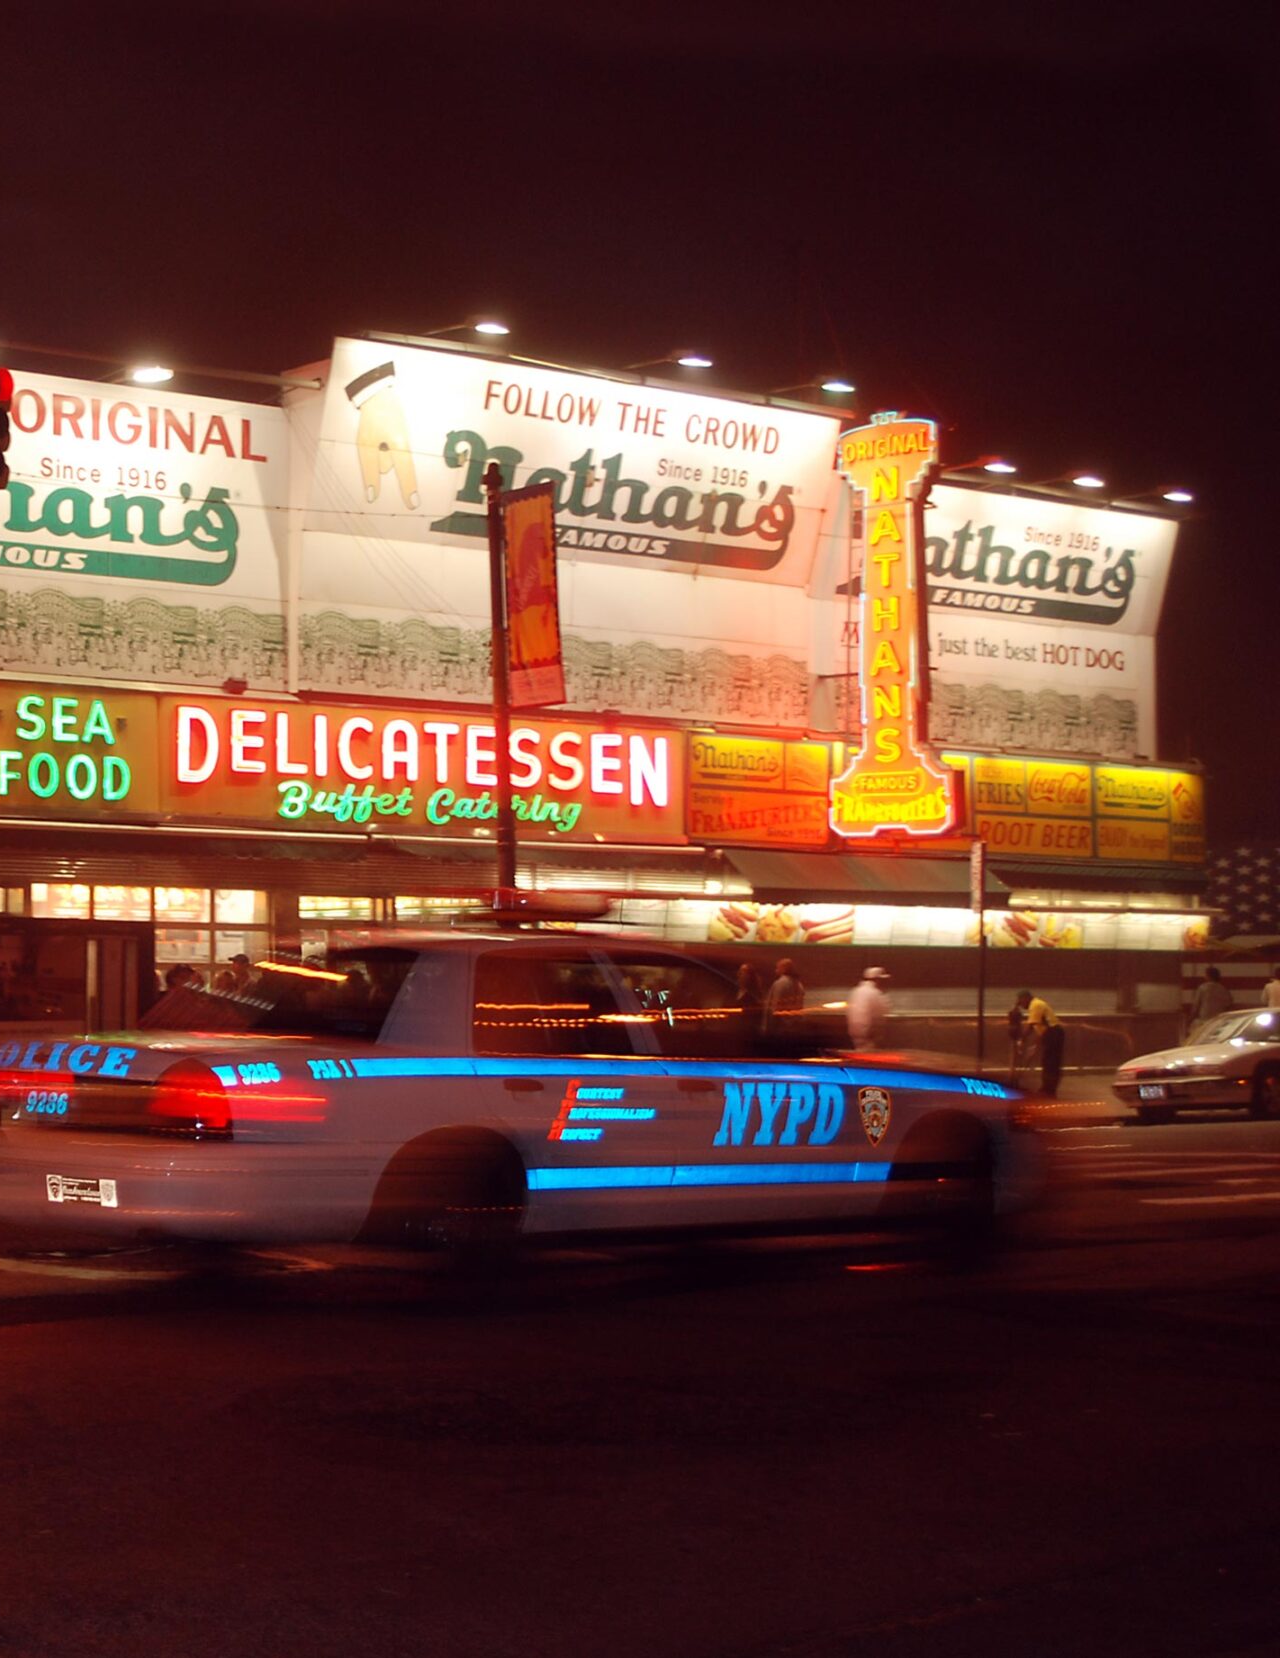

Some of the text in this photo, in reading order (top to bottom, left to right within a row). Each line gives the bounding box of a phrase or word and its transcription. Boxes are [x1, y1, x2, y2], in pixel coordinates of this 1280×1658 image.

[11, 388, 269, 464] ORIGINAL
[484, 379, 781, 456] FOLLOW THE CROWD
[842, 429, 930, 463] ORIGINAL
[40, 456, 168, 492] Since 1916
[657, 457, 749, 488] Since 1916
[1023, 525, 1100, 552] Since 1916
[924, 519, 1137, 600] athan's
[869, 465, 902, 764] NATHANS
[933, 589, 1036, 615] FAMOUS
[937, 632, 1125, 672] just the best HOT DOG
[15, 694, 116, 745] SEA
[176, 704, 668, 808] DELICATESSEN
[859, 775, 918, 790] FAMOUS
[976, 781, 1024, 806] FRIES
[277, 779, 582, 833] Buffet Catring
[980, 820, 1035, 847] ROOT
[1040, 823, 1092, 849] BEER
[712, 1082, 847, 1147] NYPD
